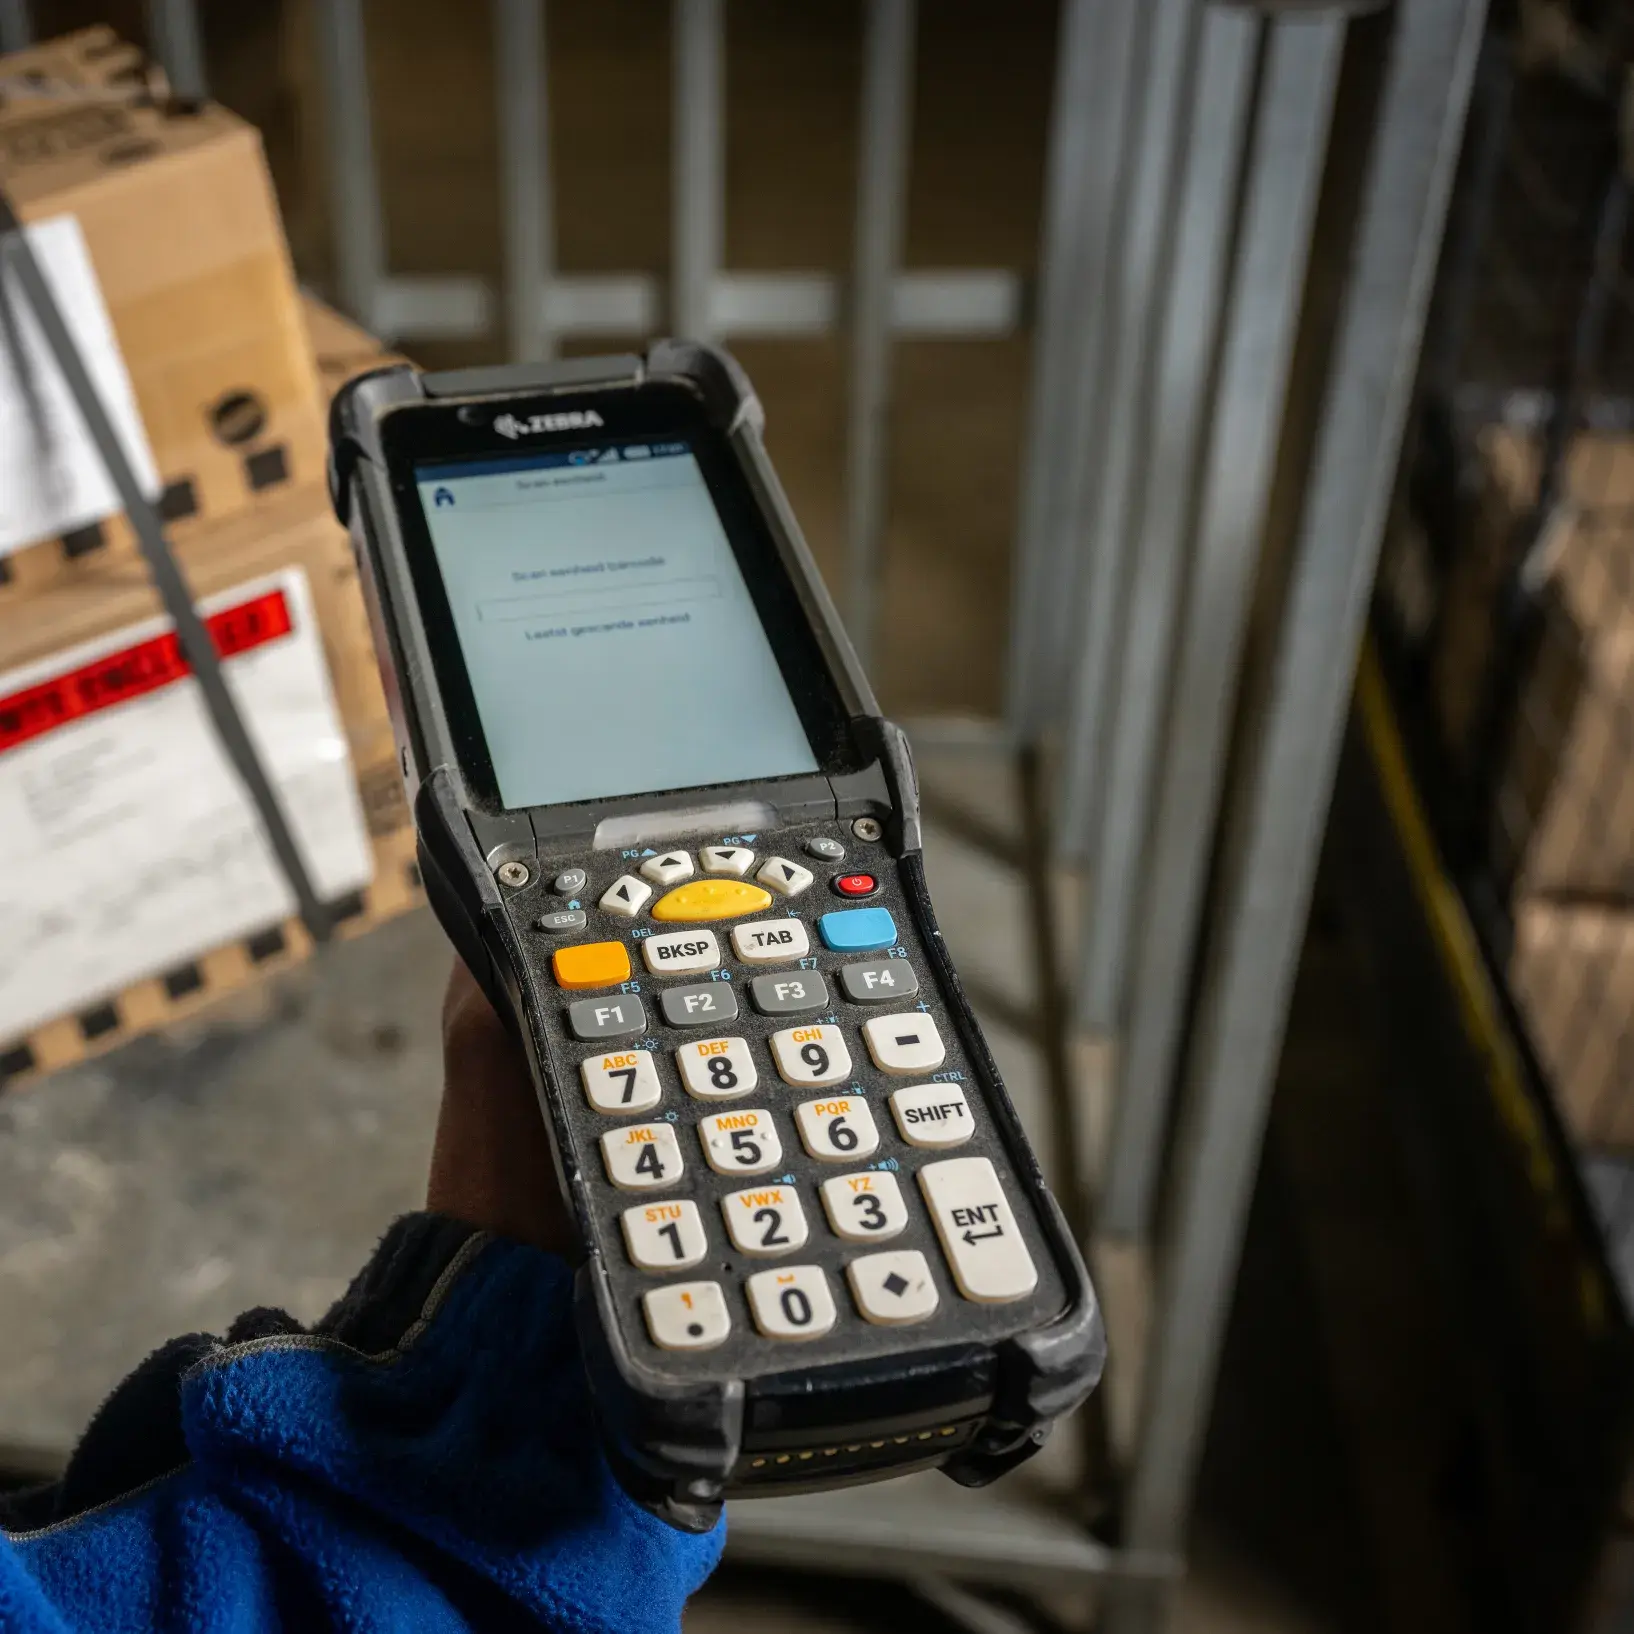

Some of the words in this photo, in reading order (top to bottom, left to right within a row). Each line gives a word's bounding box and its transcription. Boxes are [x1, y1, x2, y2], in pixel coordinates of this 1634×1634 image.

[527, 409, 604, 434] ZEBRA
[722, 835, 740, 846] PG
[819, 840, 837, 853] P2
[622, 848, 640, 860] PG
[562, 873, 580, 886] P1
[553, 913, 577, 925] ESC
[632, 927, 656, 940] DEL
[751, 930, 794, 948] TAB
[656, 940, 710, 961] BKSP
[887, 945, 908, 959] F8
[799, 957, 818, 971] F7
[710, 968, 732, 982] F6
[862, 969, 896, 990] F4
[621, 980, 641, 995] F5
[773, 981, 807, 1001] F3
[683, 993, 717, 1013] F2
[594, 1005, 625, 1027] F1
[791, 1028, 823, 1044] GHI
[697, 1040, 729, 1057] DEF
[602, 1053, 638, 1070] ABC
[801, 1043, 830, 1077] 9
[708, 1056, 738, 1090] 8
[932, 1069, 966, 1083] CTRL
[608, 1068, 637, 1105] 7
[814, 1100, 852, 1117] PQR
[904, 1102, 964, 1124] SHIFT
[717, 1114, 758, 1130] MNO
[626, 1129, 658, 1145] JKL
[827, 1116, 859, 1152] 6
[730, 1129, 762, 1165] 5
[635, 1143, 665, 1180] 4
[848, 1176, 873, 1193] YZ
[740, 1190, 783, 1208] VWX
[645, 1205, 682, 1223] STU
[853, 1193, 887, 1231] 3
[951, 1203, 1000, 1229] ENT
[753, 1208, 790, 1247] 2
[658, 1222, 685, 1260] 1
[780, 1288, 813, 1327] 0
